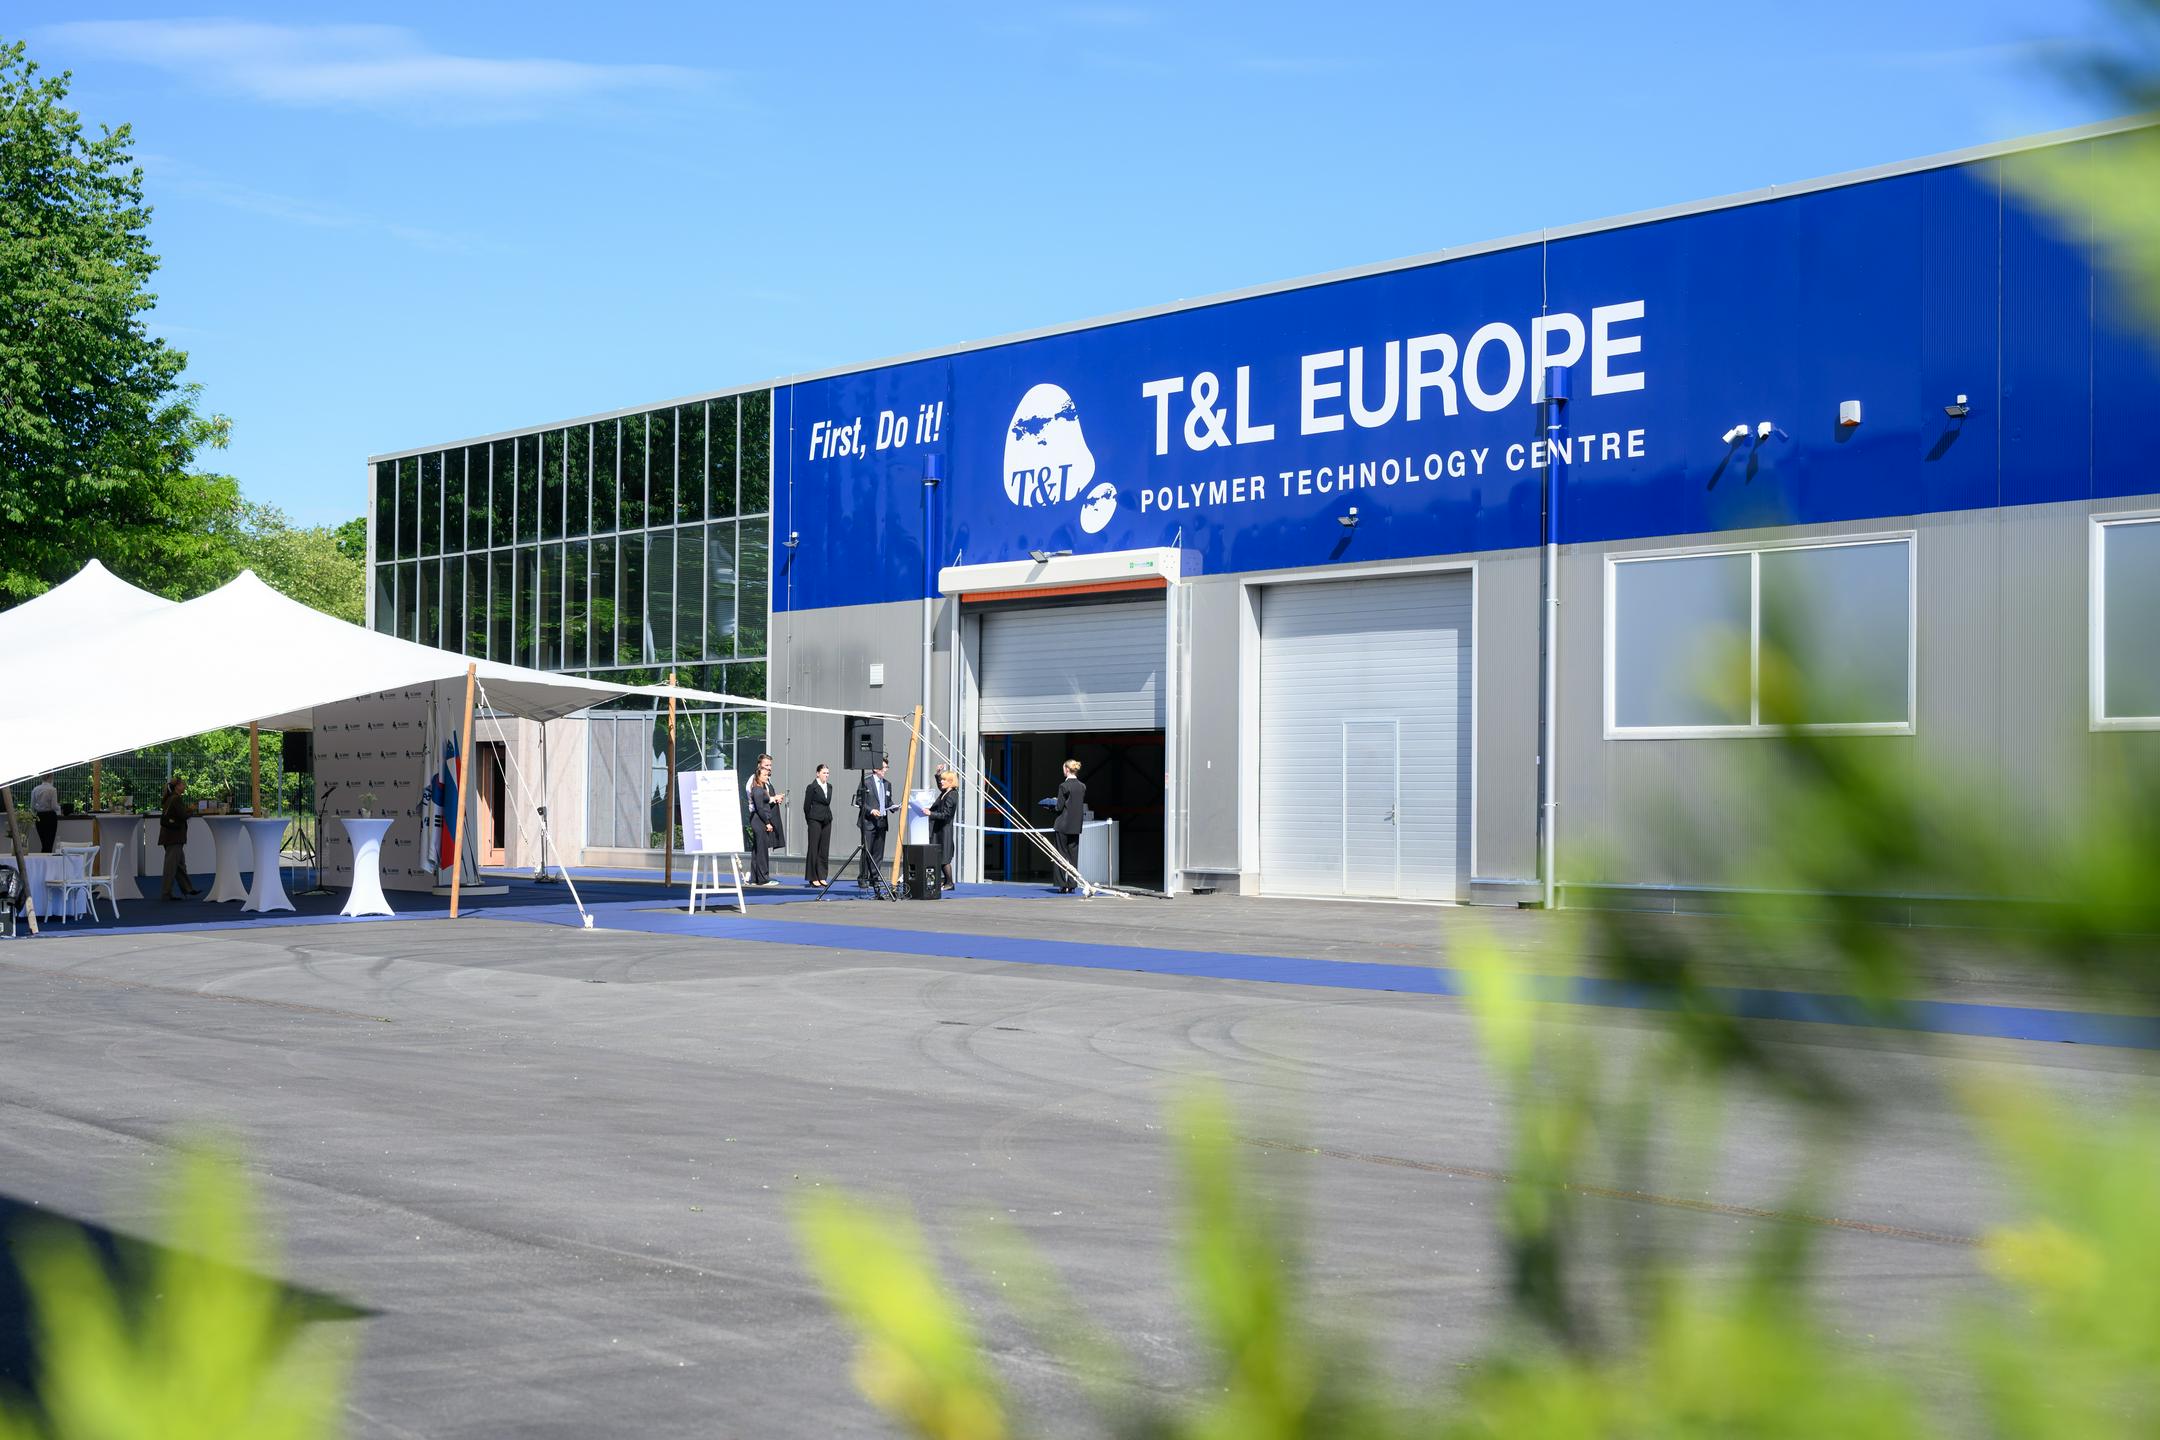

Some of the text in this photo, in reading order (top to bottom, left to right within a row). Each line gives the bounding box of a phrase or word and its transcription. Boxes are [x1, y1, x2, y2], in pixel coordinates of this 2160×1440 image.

[1143, 300, 1645, 456] T&L EUROPE
[808, 401, 944, 461] First, Do it!
[1011, 464, 1081, 507] T&L
[1141, 429, 1645, 513] POLYMER TECHNOLOGY CENTRE
